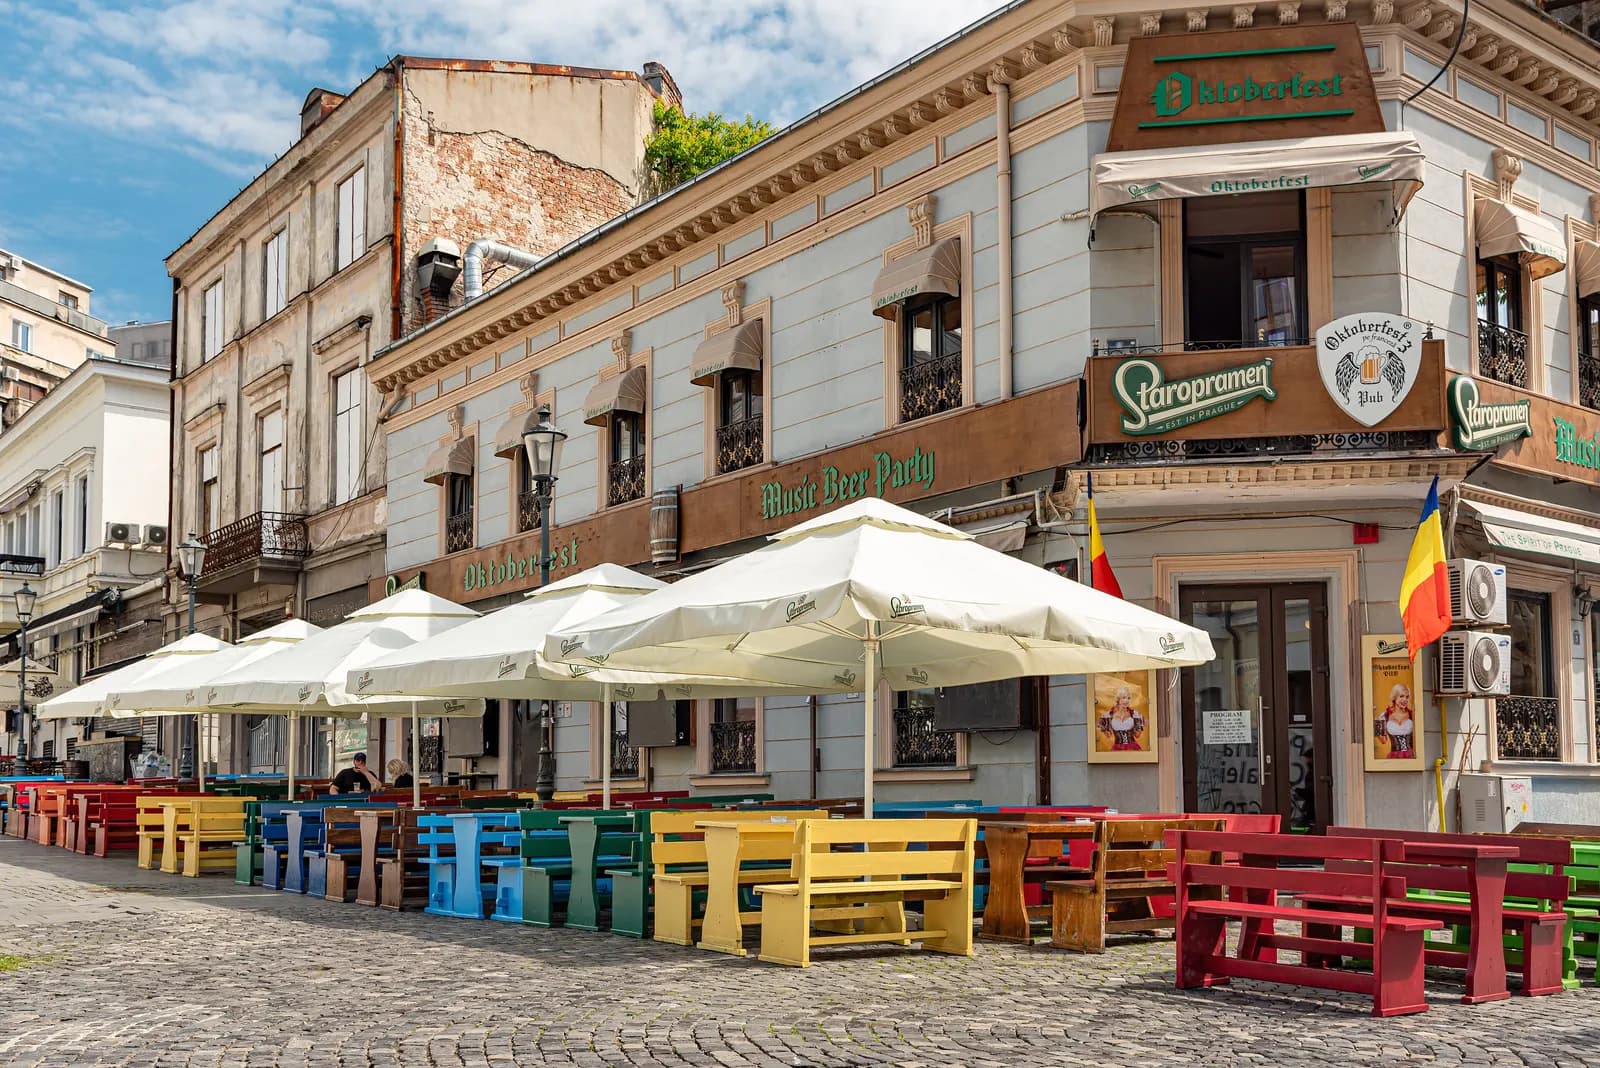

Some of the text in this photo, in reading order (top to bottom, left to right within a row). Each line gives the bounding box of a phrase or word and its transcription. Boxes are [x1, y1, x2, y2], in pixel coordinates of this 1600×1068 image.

[1150, 71, 1344, 117] Oktoberfest
[1210, 174, 1310, 193] Oktoberfest
[1324, 318, 1409, 351] Oktoberfest
[1115, 357, 1274, 432] Staropramen
[1186, 414, 1196, 423] IN
[1198, 402, 1236, 418] PRAGUE
[1358, 390, 1383, 407] Pub
[1455, 376, 1532, 443] Staropramen
[761, 447, 935, 520] Music Beer Party
[464, 538, 580, 592] Oktoberest
